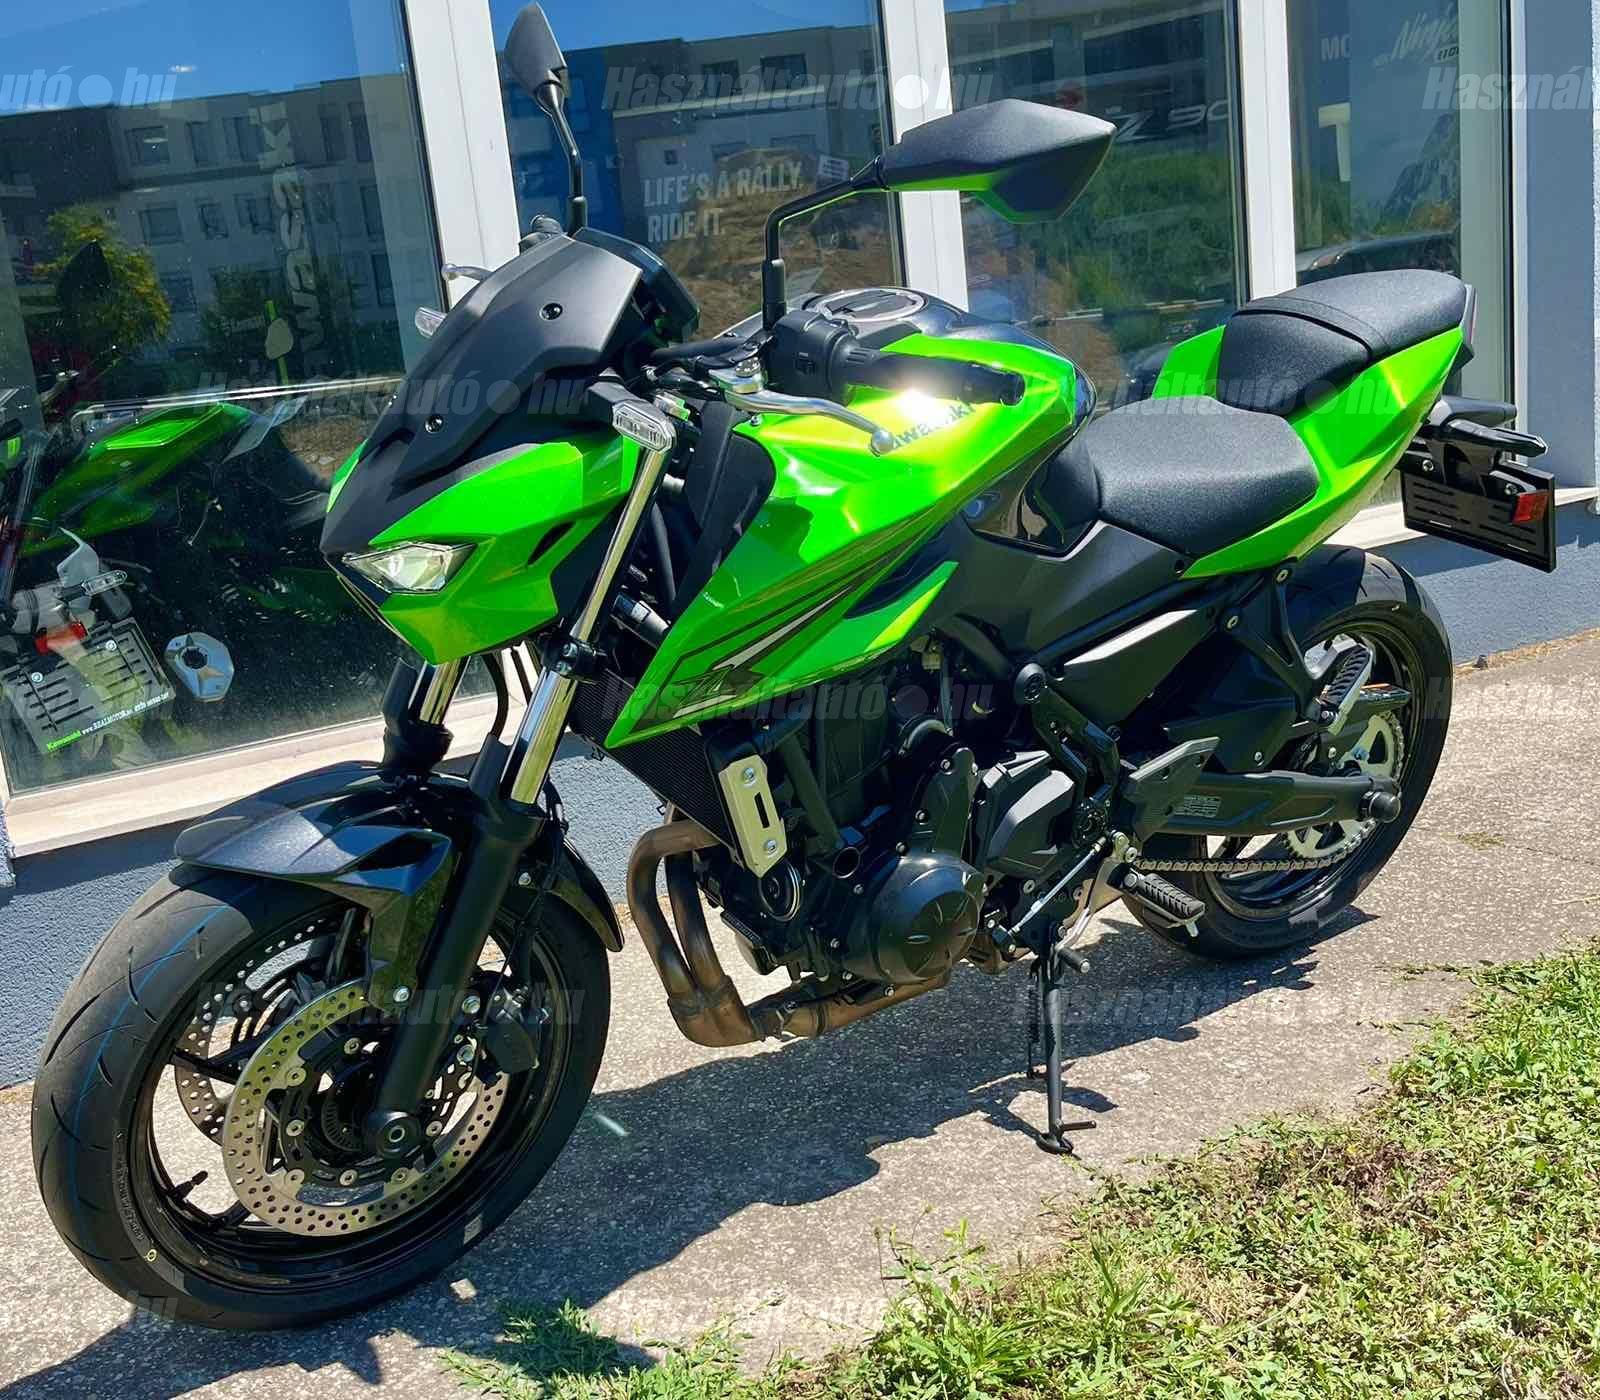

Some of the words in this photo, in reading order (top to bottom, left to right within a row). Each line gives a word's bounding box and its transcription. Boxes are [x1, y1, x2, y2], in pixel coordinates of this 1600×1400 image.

[643, 172, 710, 208] LIFE'S
[716, 170, 731, 200] A
[647, 211, 698, 243] RIDE
